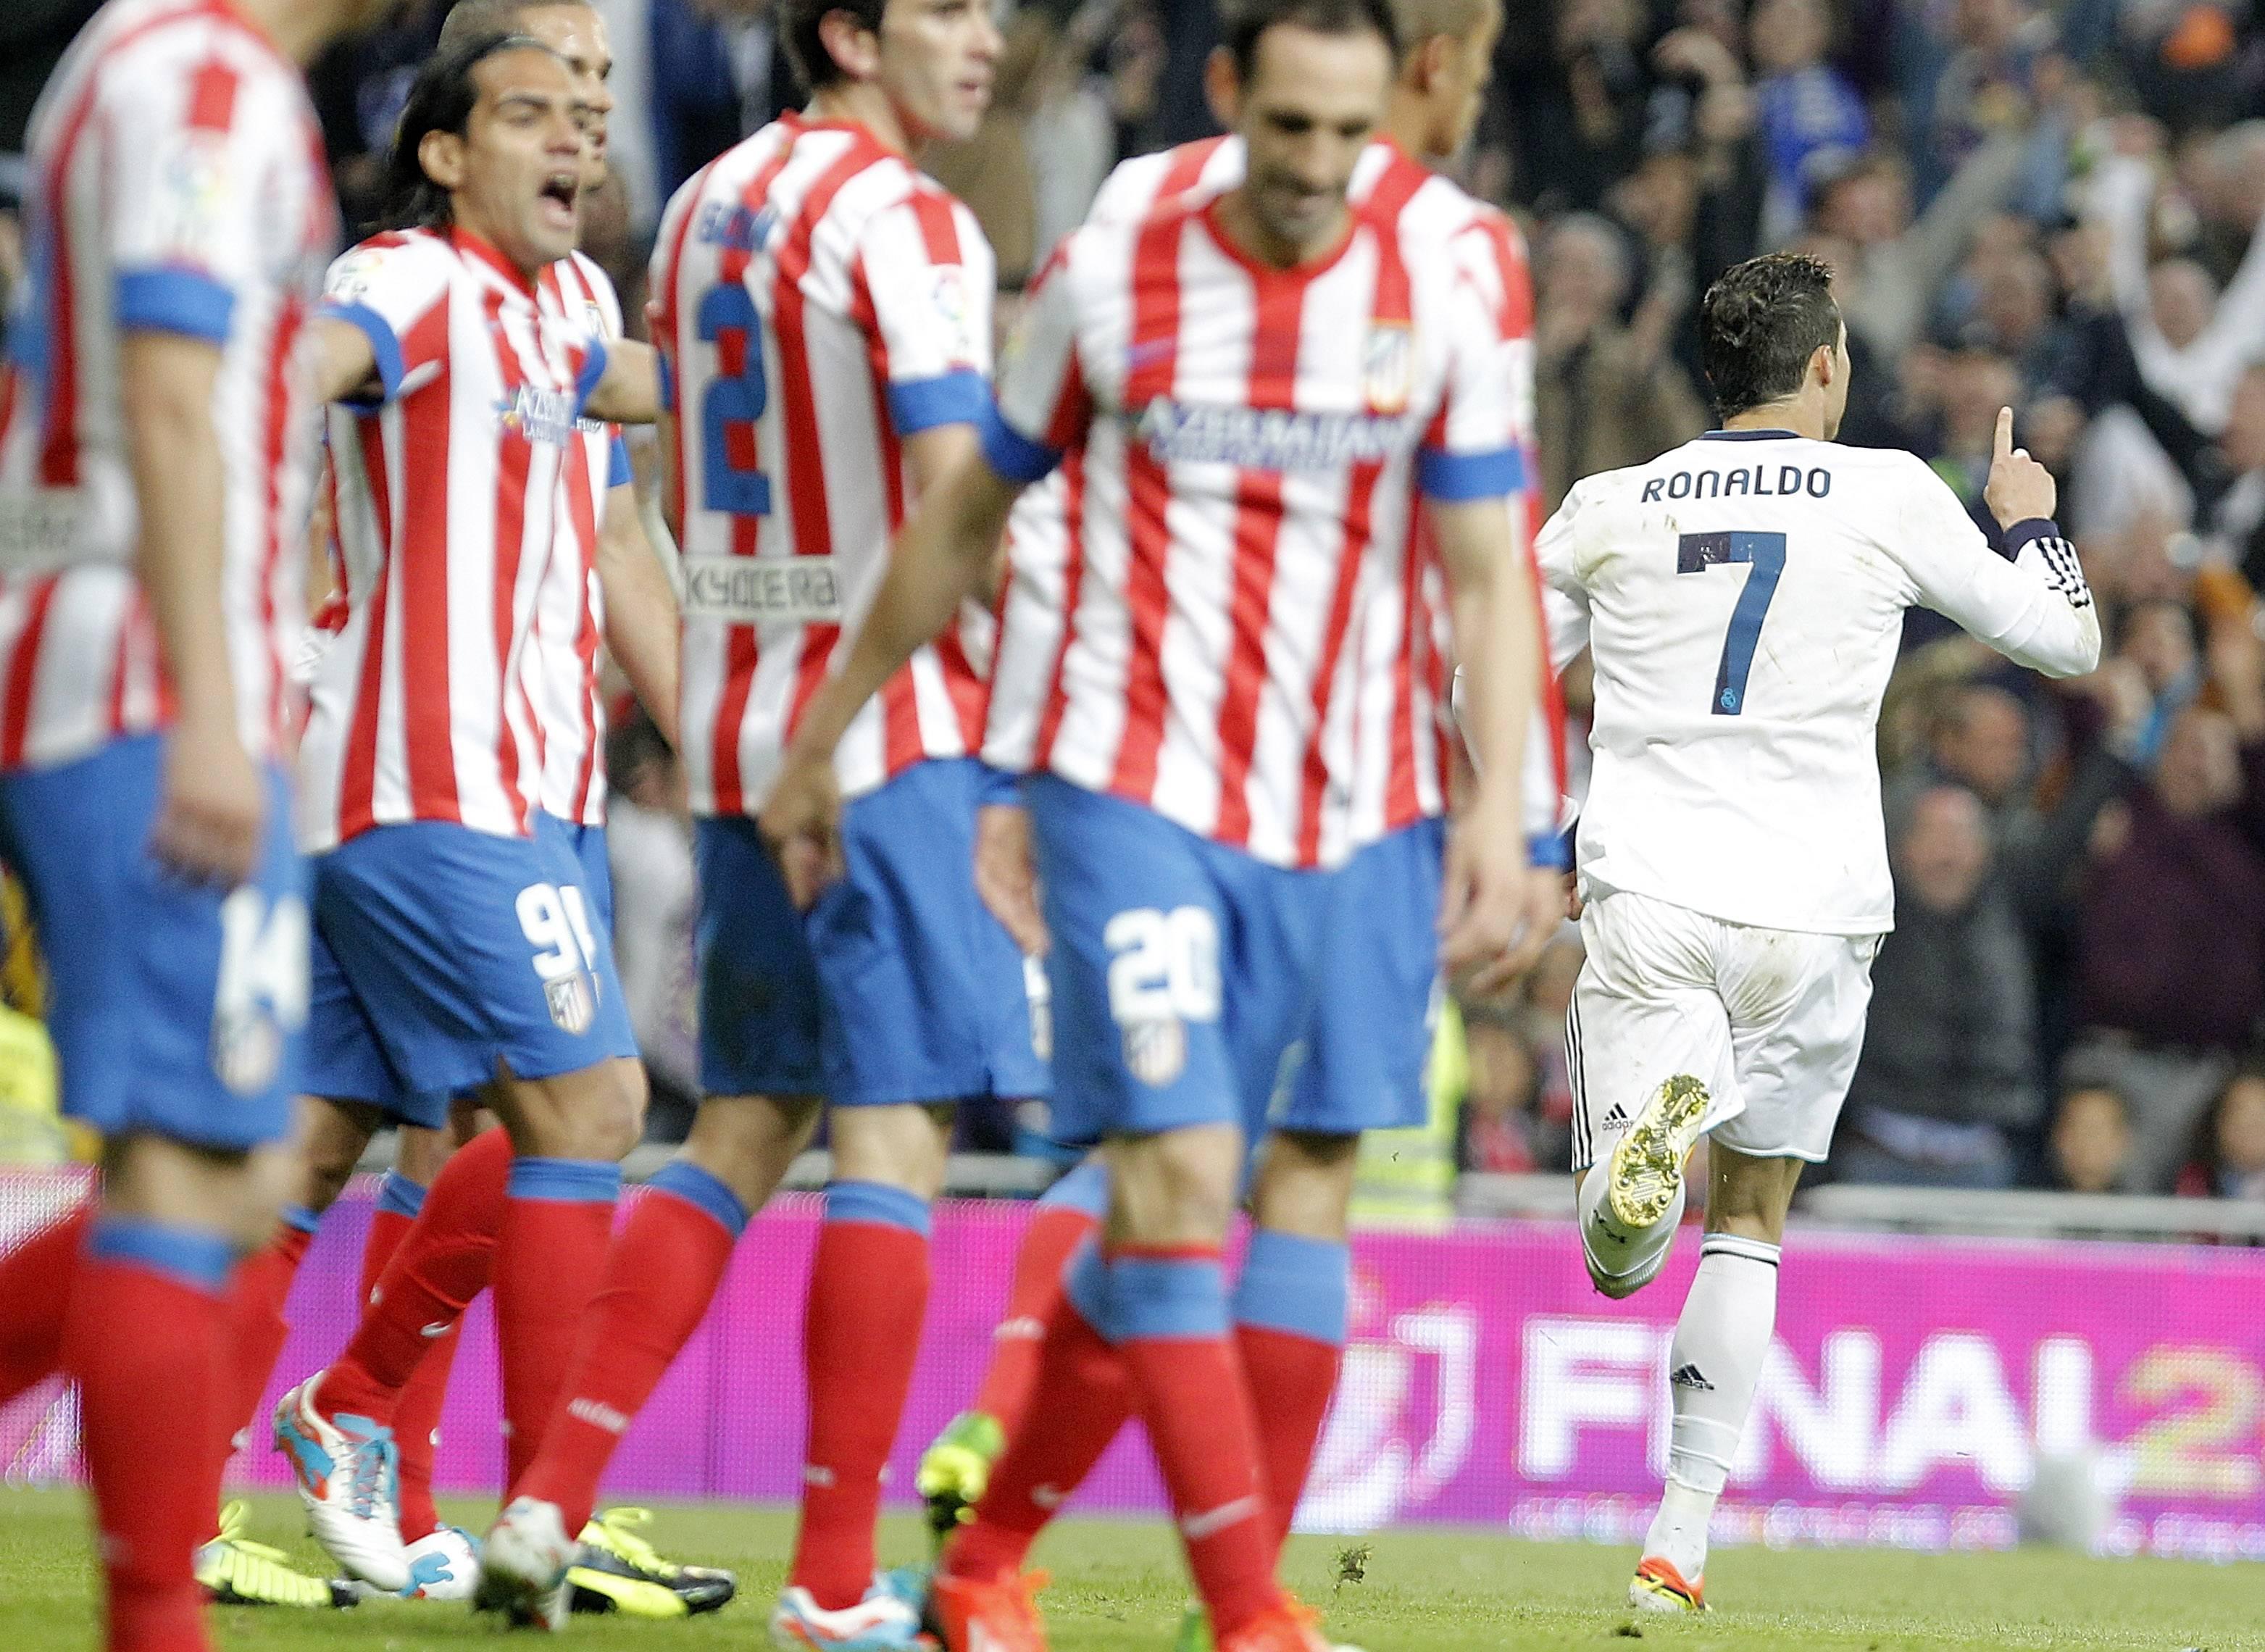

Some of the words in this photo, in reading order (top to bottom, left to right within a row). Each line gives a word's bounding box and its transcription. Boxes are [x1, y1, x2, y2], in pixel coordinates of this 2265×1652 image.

[696, 283, 771, 514] 2
[1641, 464, 1831, 502] RONALDO
[1677, 531, 1787, 715] 7
[1103, 906, 1224, 1022] 20
